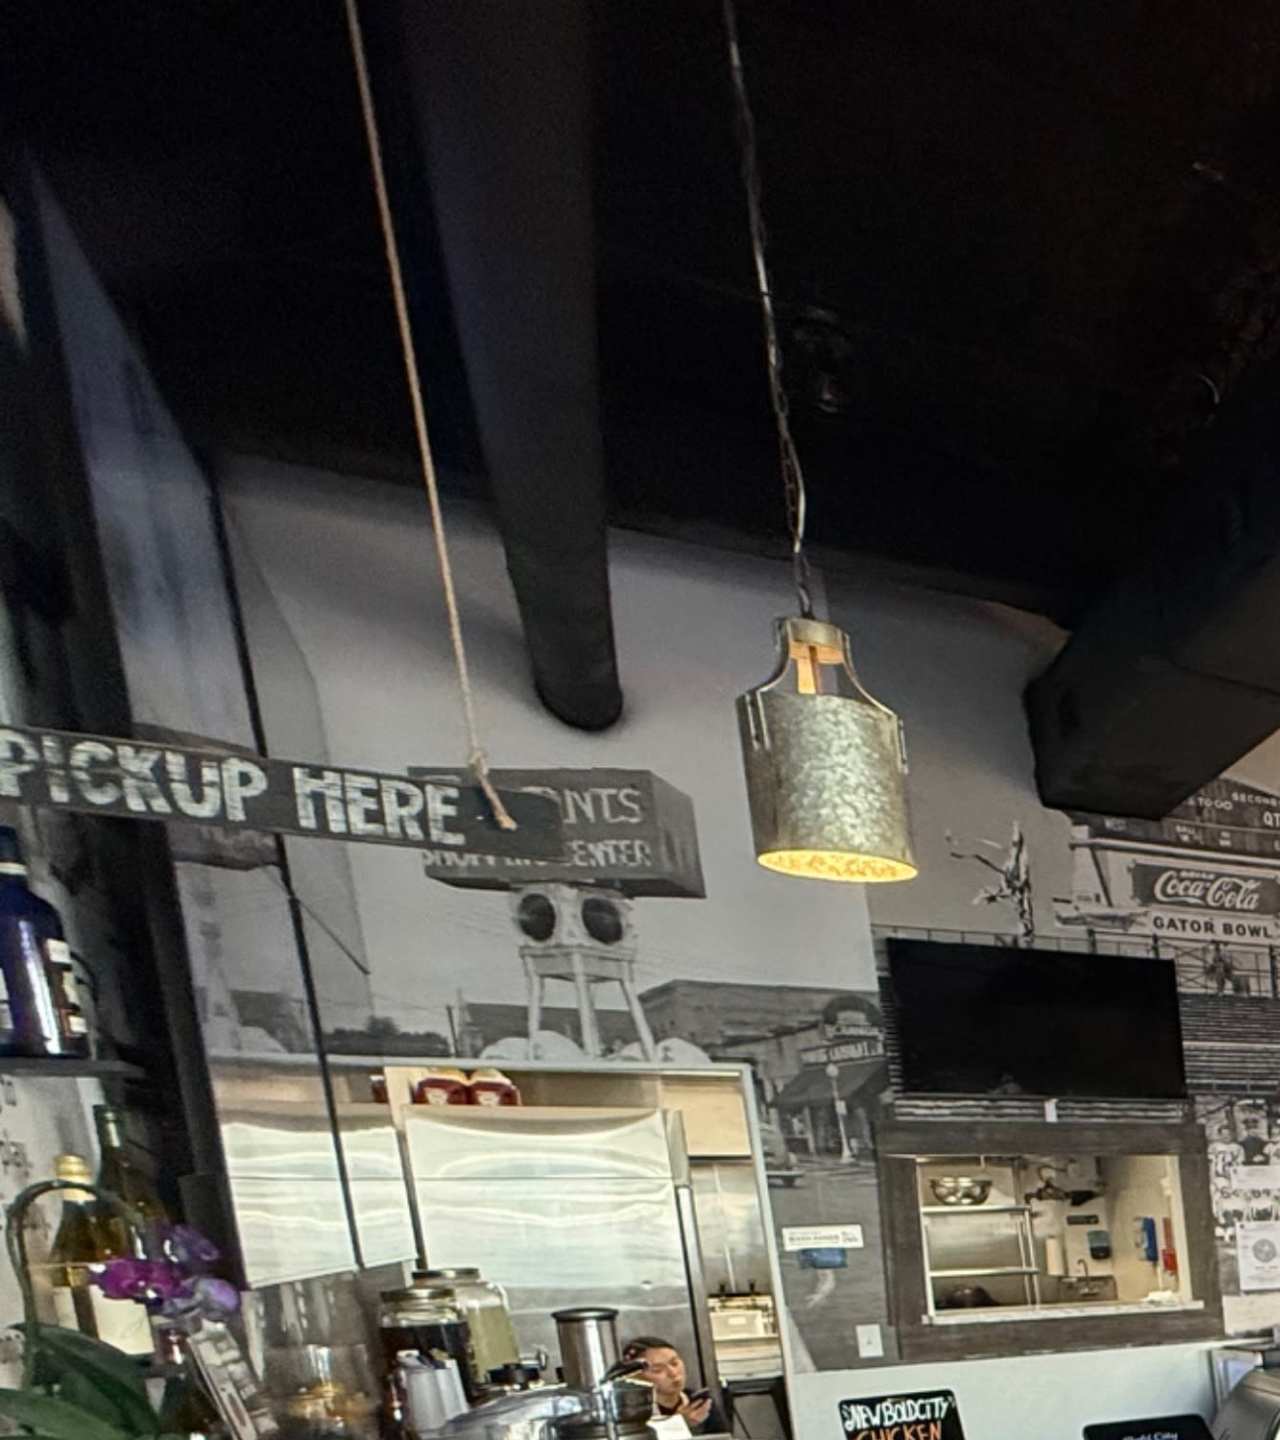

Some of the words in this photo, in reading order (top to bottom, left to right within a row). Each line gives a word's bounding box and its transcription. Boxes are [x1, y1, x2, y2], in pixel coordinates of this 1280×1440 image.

[0, 729, 268, 822] PICKUP
[291, 765, 466, 846] HERE
[1154, 871, 1261, 909] Coca-Cola
[1153, 916, 1215, 935] GATOR
[1222, 922, 1272, 938] BOWL
